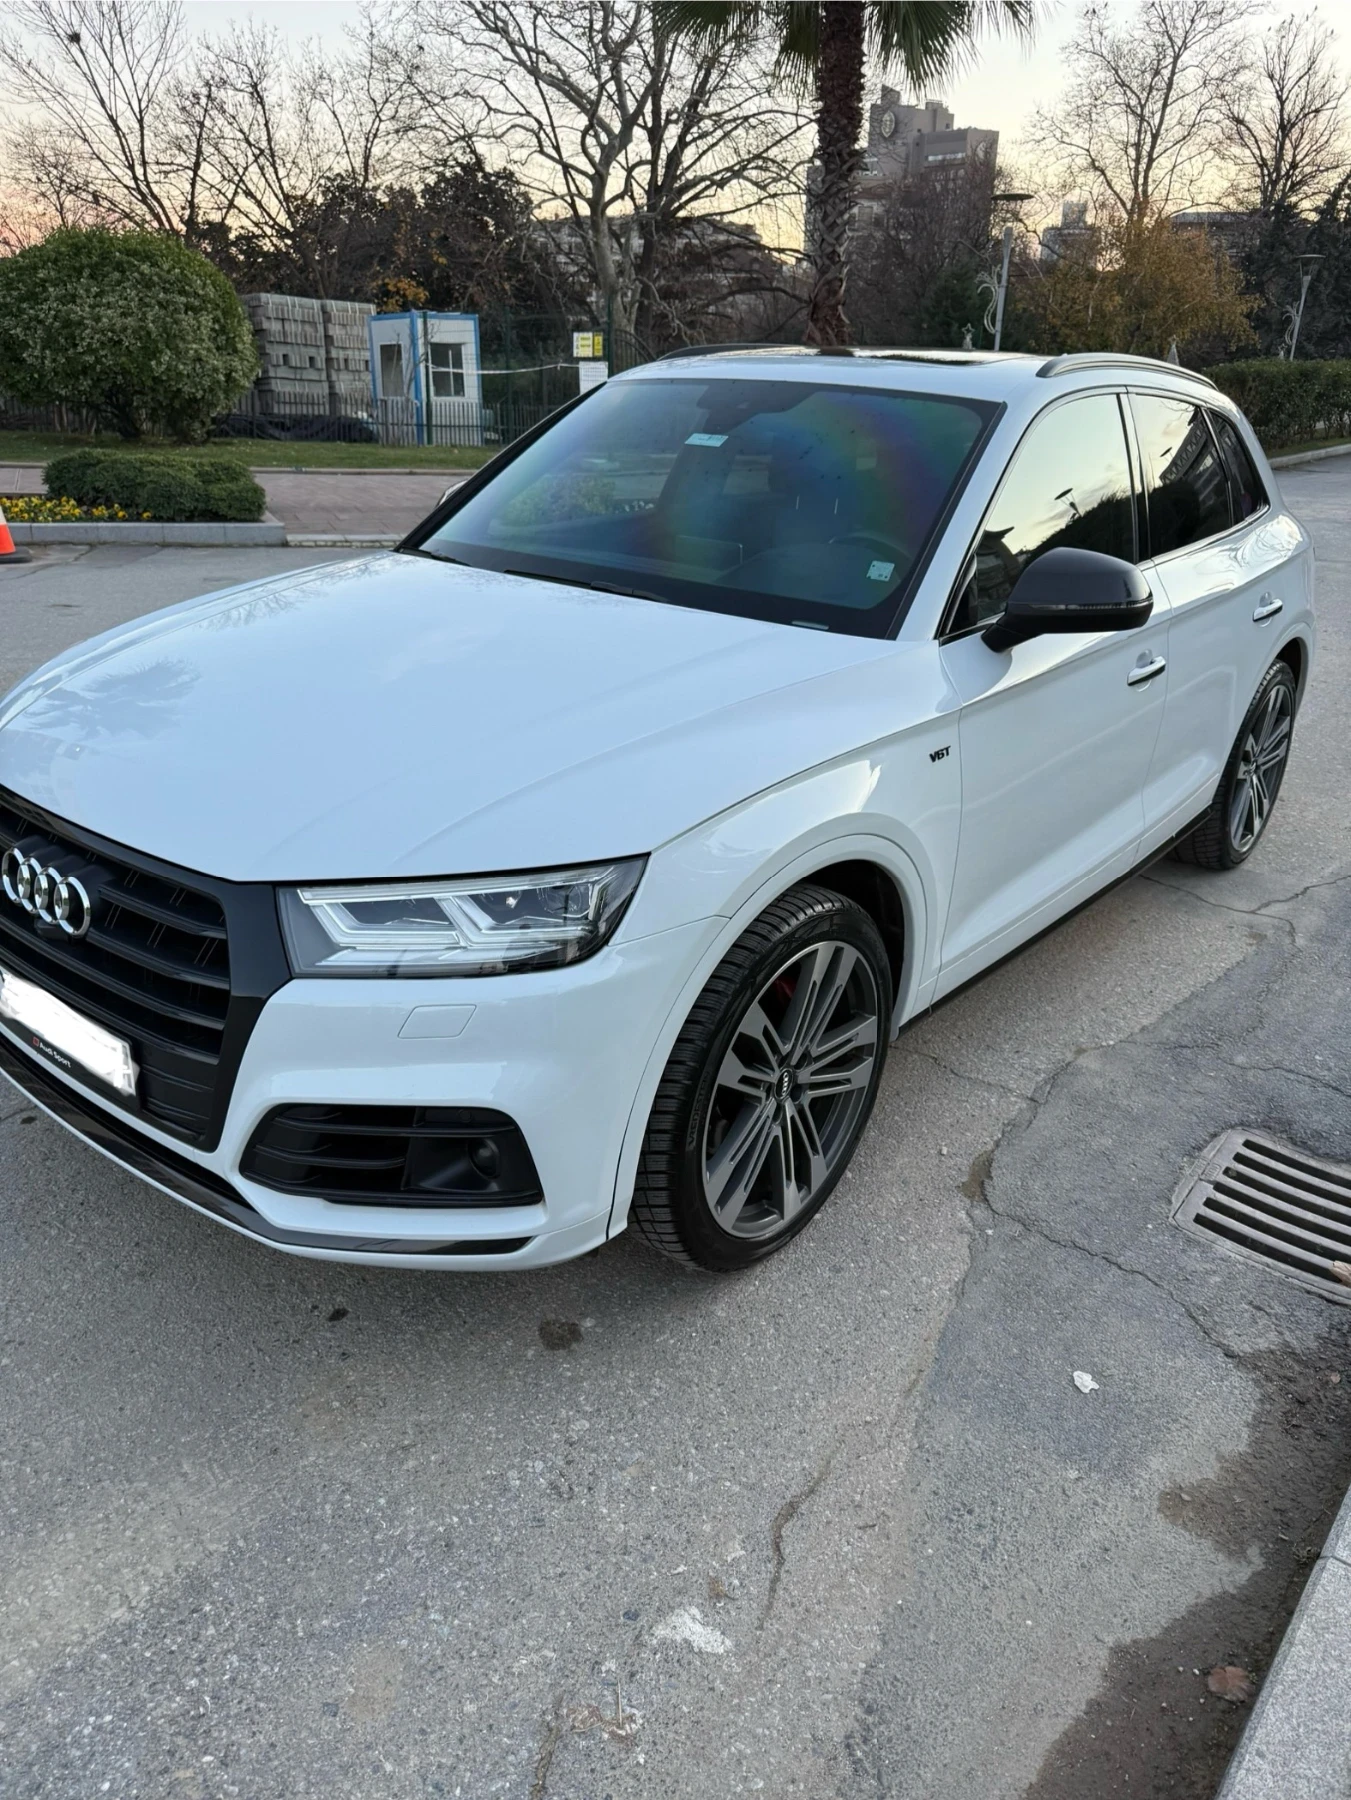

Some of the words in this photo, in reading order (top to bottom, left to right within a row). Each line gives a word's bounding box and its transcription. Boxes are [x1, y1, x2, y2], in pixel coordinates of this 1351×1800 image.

[929, 745, 951, 763] V6T
[40, 1042, 53, 1056] Audi
[53, 1051, 71, 1068] Sport
